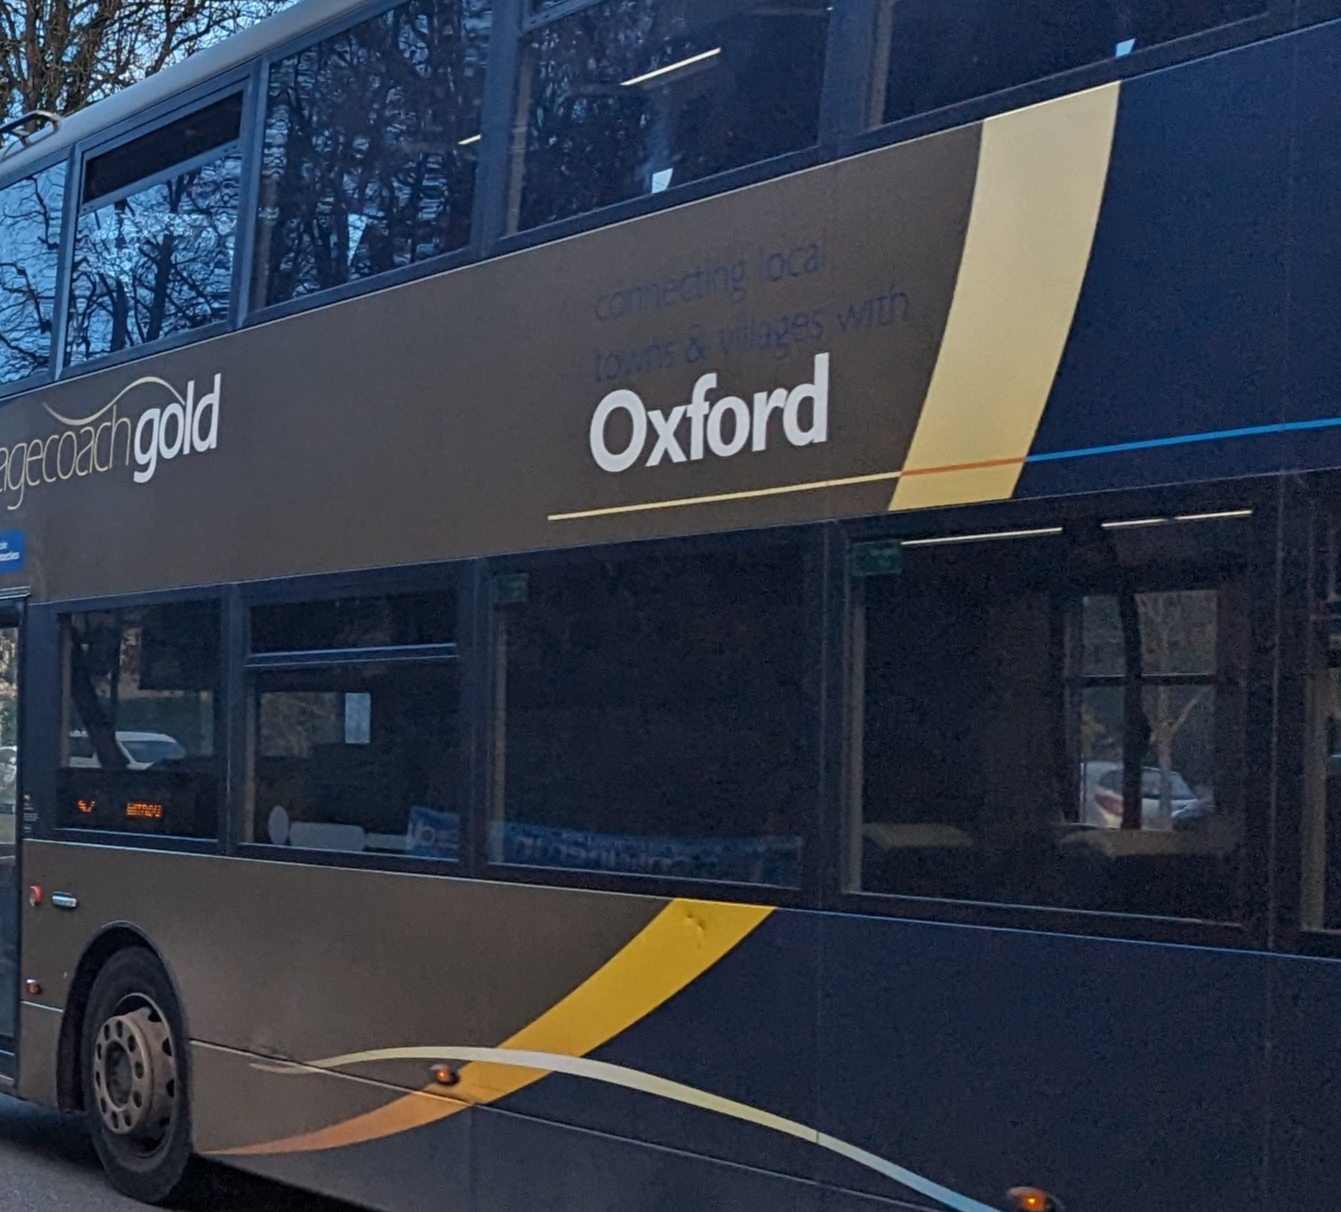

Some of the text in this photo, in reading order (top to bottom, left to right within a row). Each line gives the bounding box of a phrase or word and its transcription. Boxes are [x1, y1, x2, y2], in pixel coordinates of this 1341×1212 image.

[594, 228, 827, 322] connecting local
[593, 283, 911, 382] towns & villages with
[589, 352, 830, 474] Oxford
